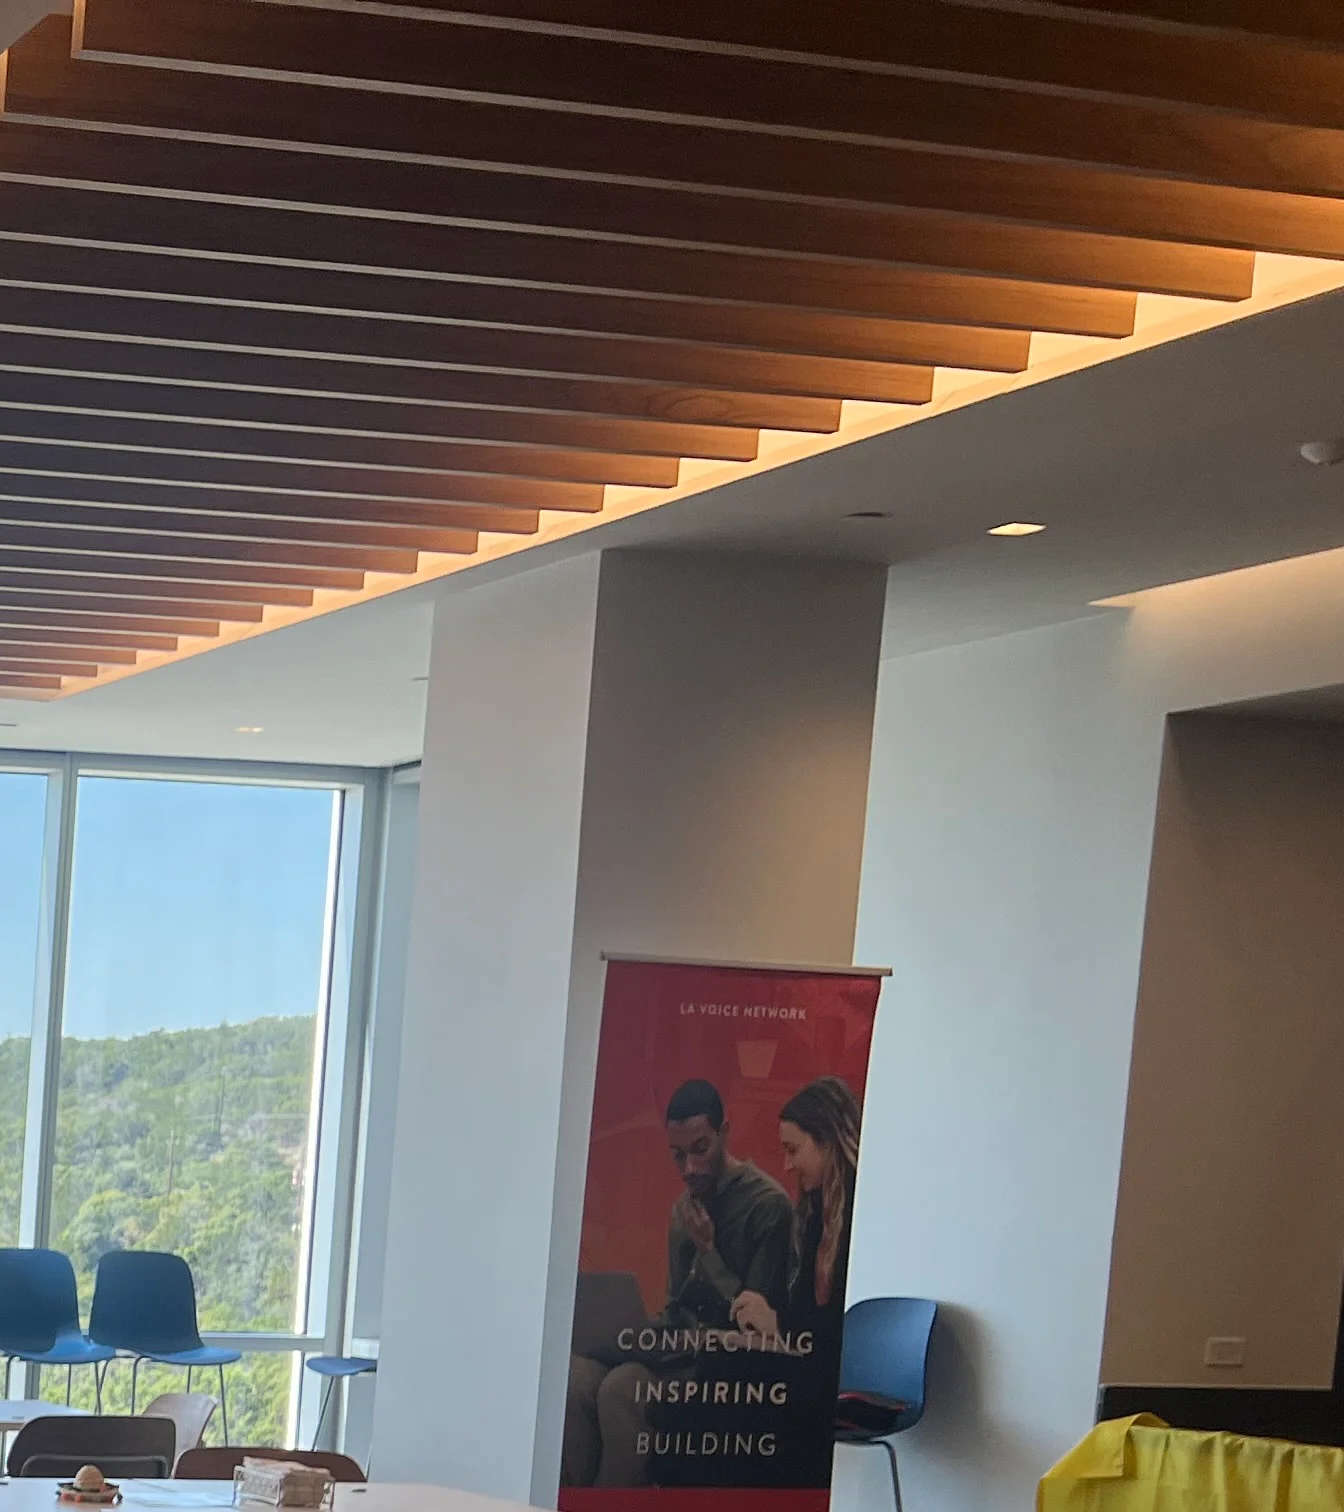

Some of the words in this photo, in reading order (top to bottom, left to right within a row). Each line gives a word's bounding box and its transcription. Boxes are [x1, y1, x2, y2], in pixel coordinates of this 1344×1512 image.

[679, 1002, 695, 1015] LA
[699, 1003, 739, 1017] VOICE
[743, 1005, 807, 1020] NETWORK
[616, 1327, 813, 1354] CONNECTING
[634, 1379, 788, 1405] INSPIRING
[635, 1431, 777, 1456] BUILDING
